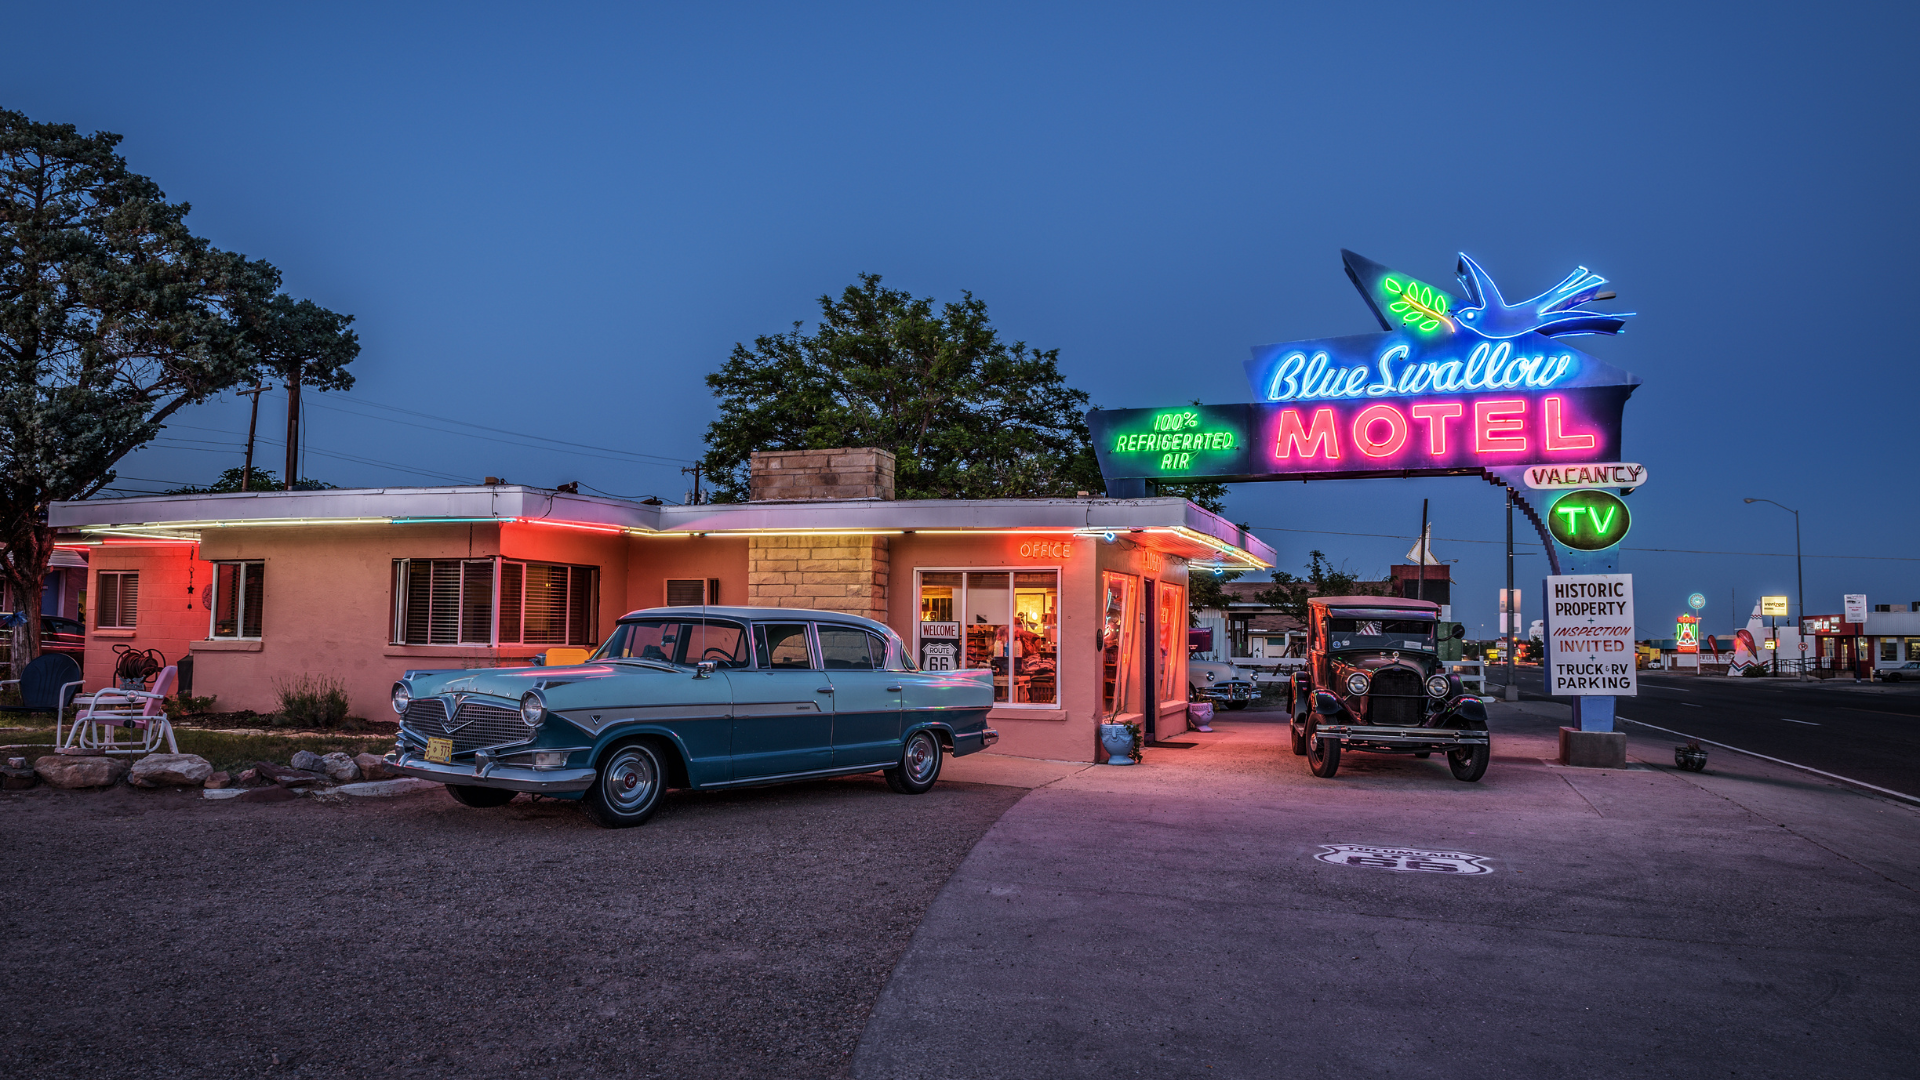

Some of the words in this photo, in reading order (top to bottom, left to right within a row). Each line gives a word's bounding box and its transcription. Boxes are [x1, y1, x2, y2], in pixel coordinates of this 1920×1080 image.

[1267, 352, 1370, 401] Blue
[1366, 341, 1571, 395] Swallow
[1154, 411, 1198, 431] 100%
[1276, 397, 1595, 459] MOTEL
[1115, 432, 1234, 452] REFRIGERATED
[1161, 452, 1190, 469] AIR
[1532, 465, 1643, 485] VACANCY
[1557, 506, 1615, 535] TV
[1020, 542, 1071, 558] OFFICE
[1554, 582, 1624, 598] HISTORIC
[1555, 601, 1627, 616] PROPERTY
[923, 625, 956, 637] WELCOME
[1553, 626, 1632, 637] INSPECTION
[1559, 640, 1625, 653] INVITED
[929, 656, 949, 671] 66
[1556, 663, 1604, 676] TRUCK
[1612, 663, 1629, 675] RV
[1557, 677, 1631, 689] PARKING
